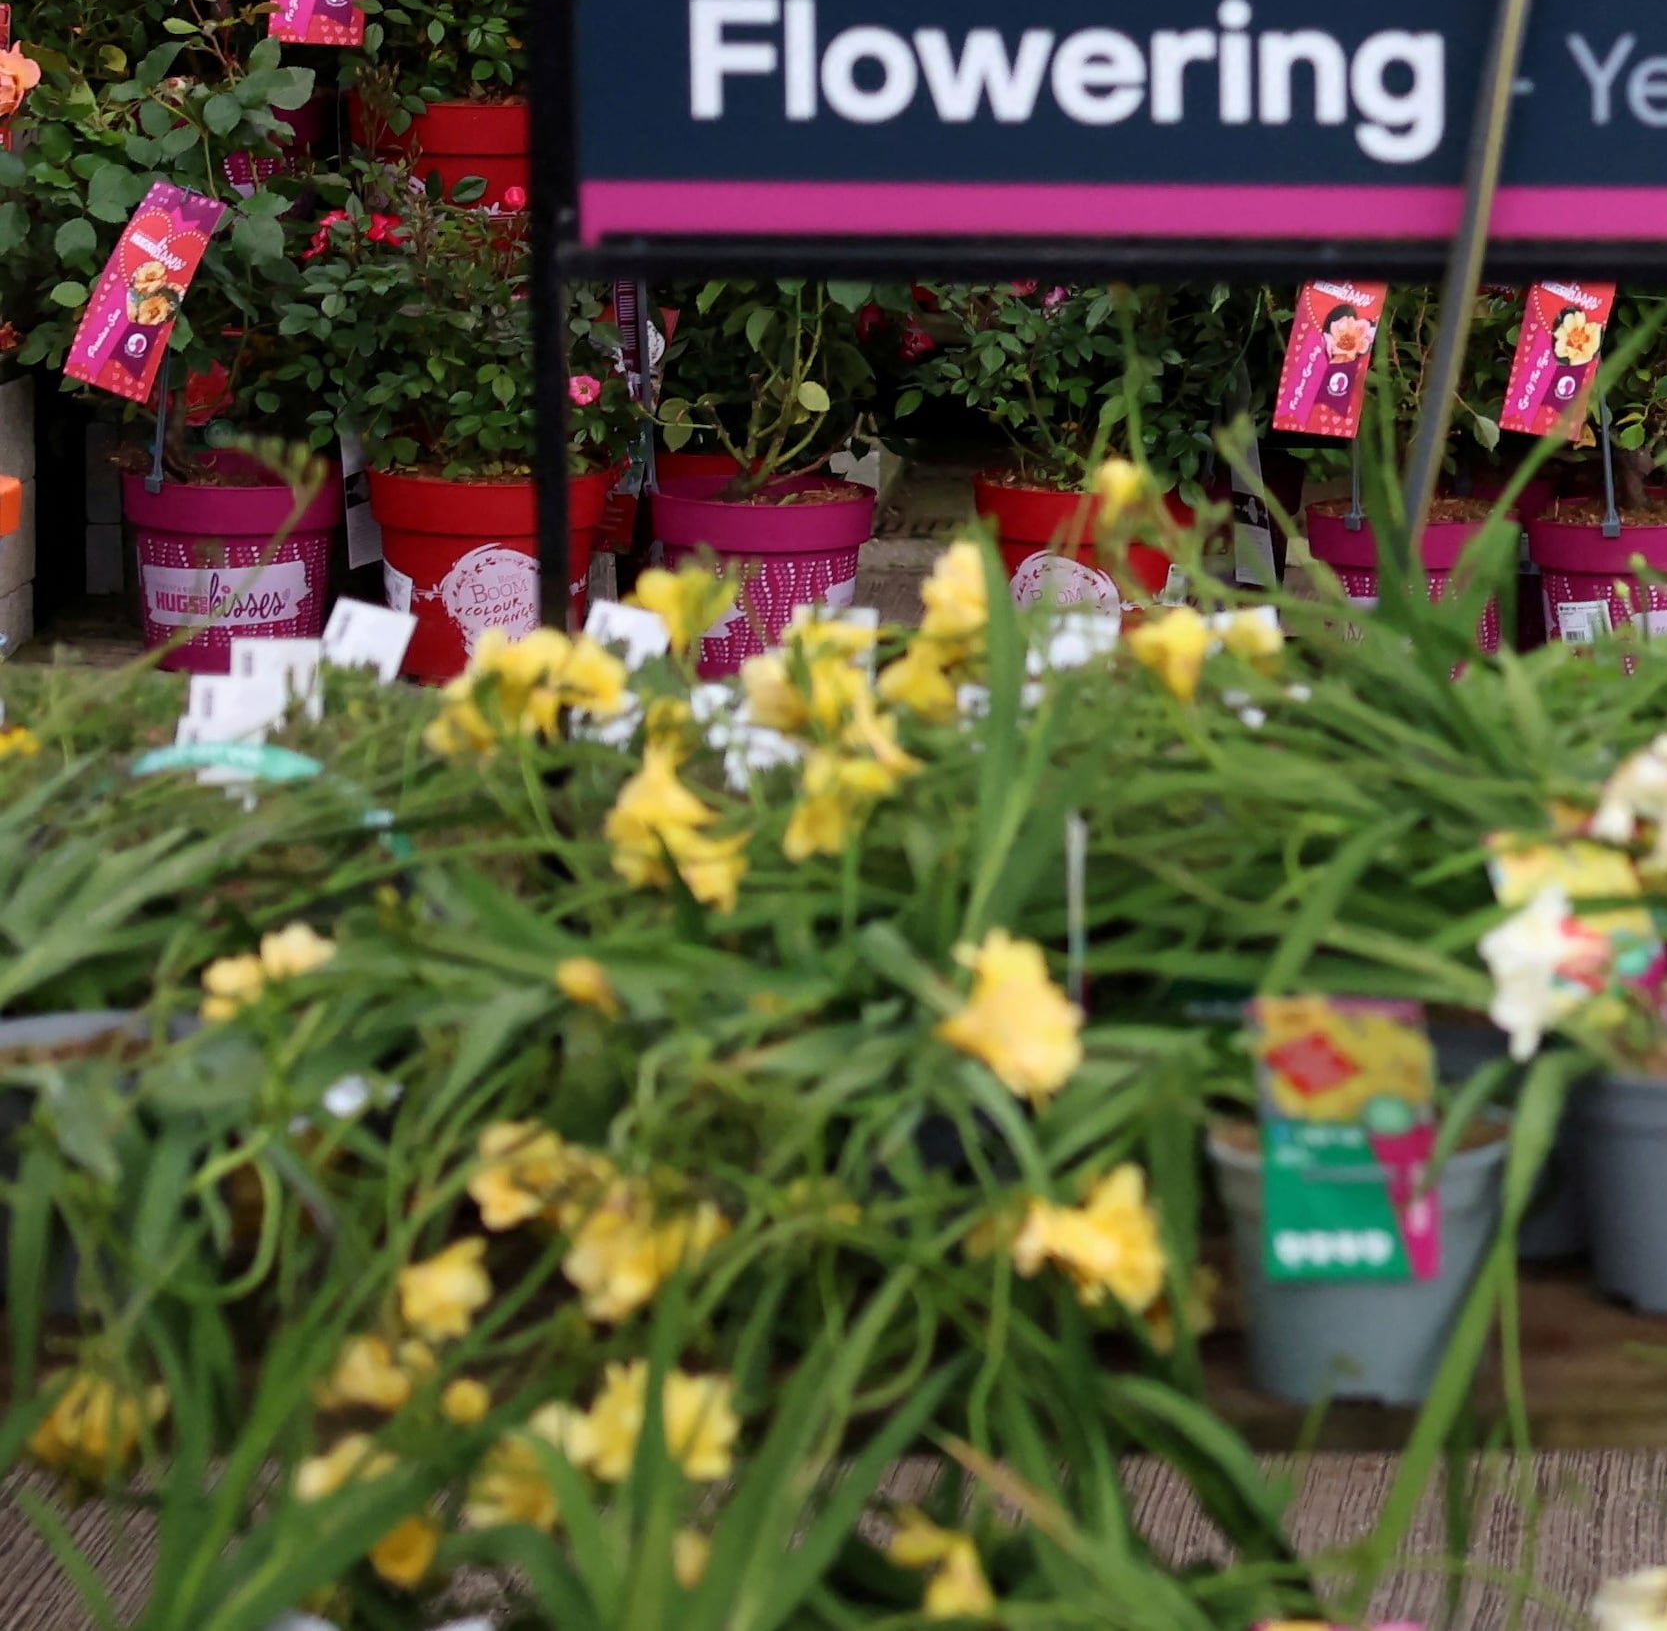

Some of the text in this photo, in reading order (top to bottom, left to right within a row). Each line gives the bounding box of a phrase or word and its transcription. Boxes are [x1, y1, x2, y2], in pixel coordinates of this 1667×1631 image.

[156, 591, 200, 614] HUGS
[208, 572, 287, 619] kisses
[465, 597, 523, 617] COLOUR
[483, 602, 536, 628] CHANGE
